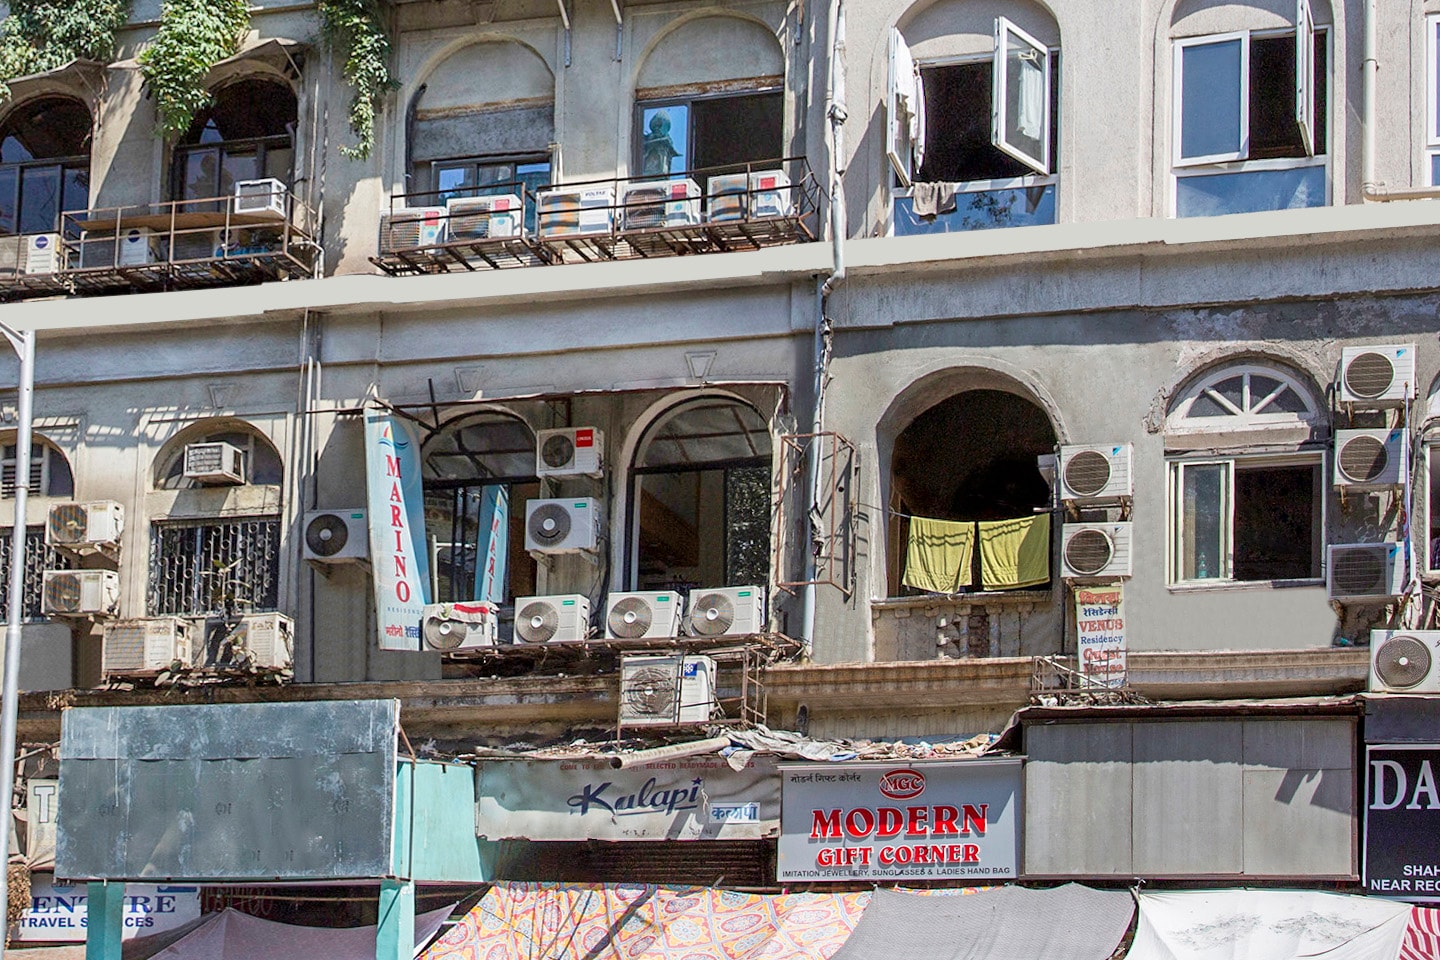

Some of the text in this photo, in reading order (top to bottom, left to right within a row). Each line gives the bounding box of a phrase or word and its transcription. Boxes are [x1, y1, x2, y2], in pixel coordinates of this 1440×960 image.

[386, 455, 410, 603] MARINO
[1079, 619, 1123, 632] VENUS
[1080, 635, 1123, 645] Residency
[885, 777, 923, 791] MGC
[33, 785, 59, 824] T
[810, 803, 989, 838] MODERN
[817, 844, 980, 867] GIFT CORNER
[782, 870, 820, 878] IMITATION
[872, 868, 926, 877] SUNGLASSES
[936, 868, 966, 876] LADIES
[967, 867, 991, 875] HAND
[992, 867, 1011, 875] BAG
[1371, 879, 1412, 891] NEAR
[20, 917, 75, 928] TRAVEL
